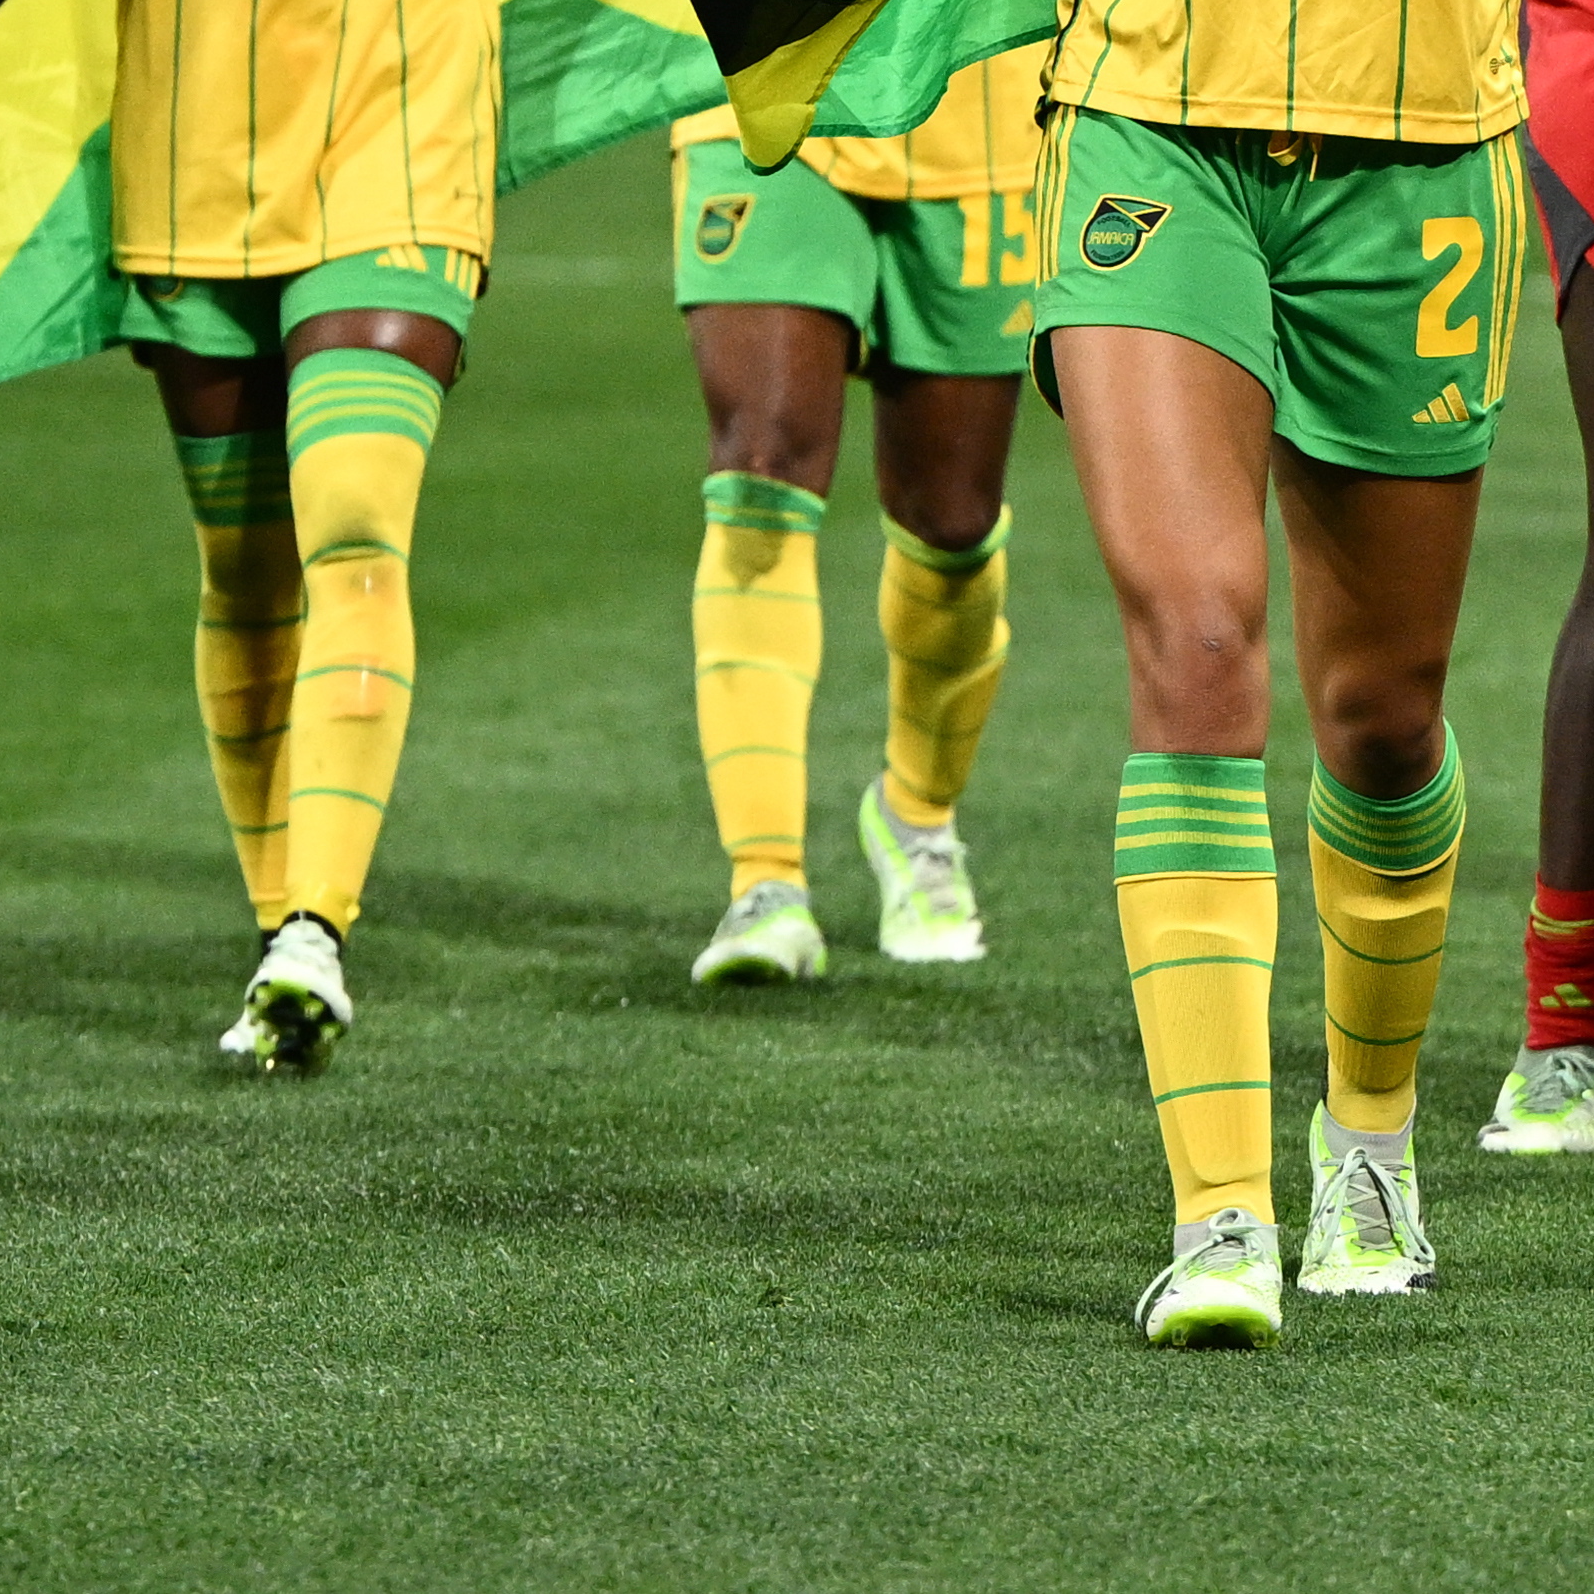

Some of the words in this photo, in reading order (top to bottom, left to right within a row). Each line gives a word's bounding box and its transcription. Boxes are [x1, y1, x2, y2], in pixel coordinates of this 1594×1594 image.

[958, 192, 1036, 286] 15
[1087, 232, 1135, 246] JAMAICA
[1415, 216, 1484, 358] 2
